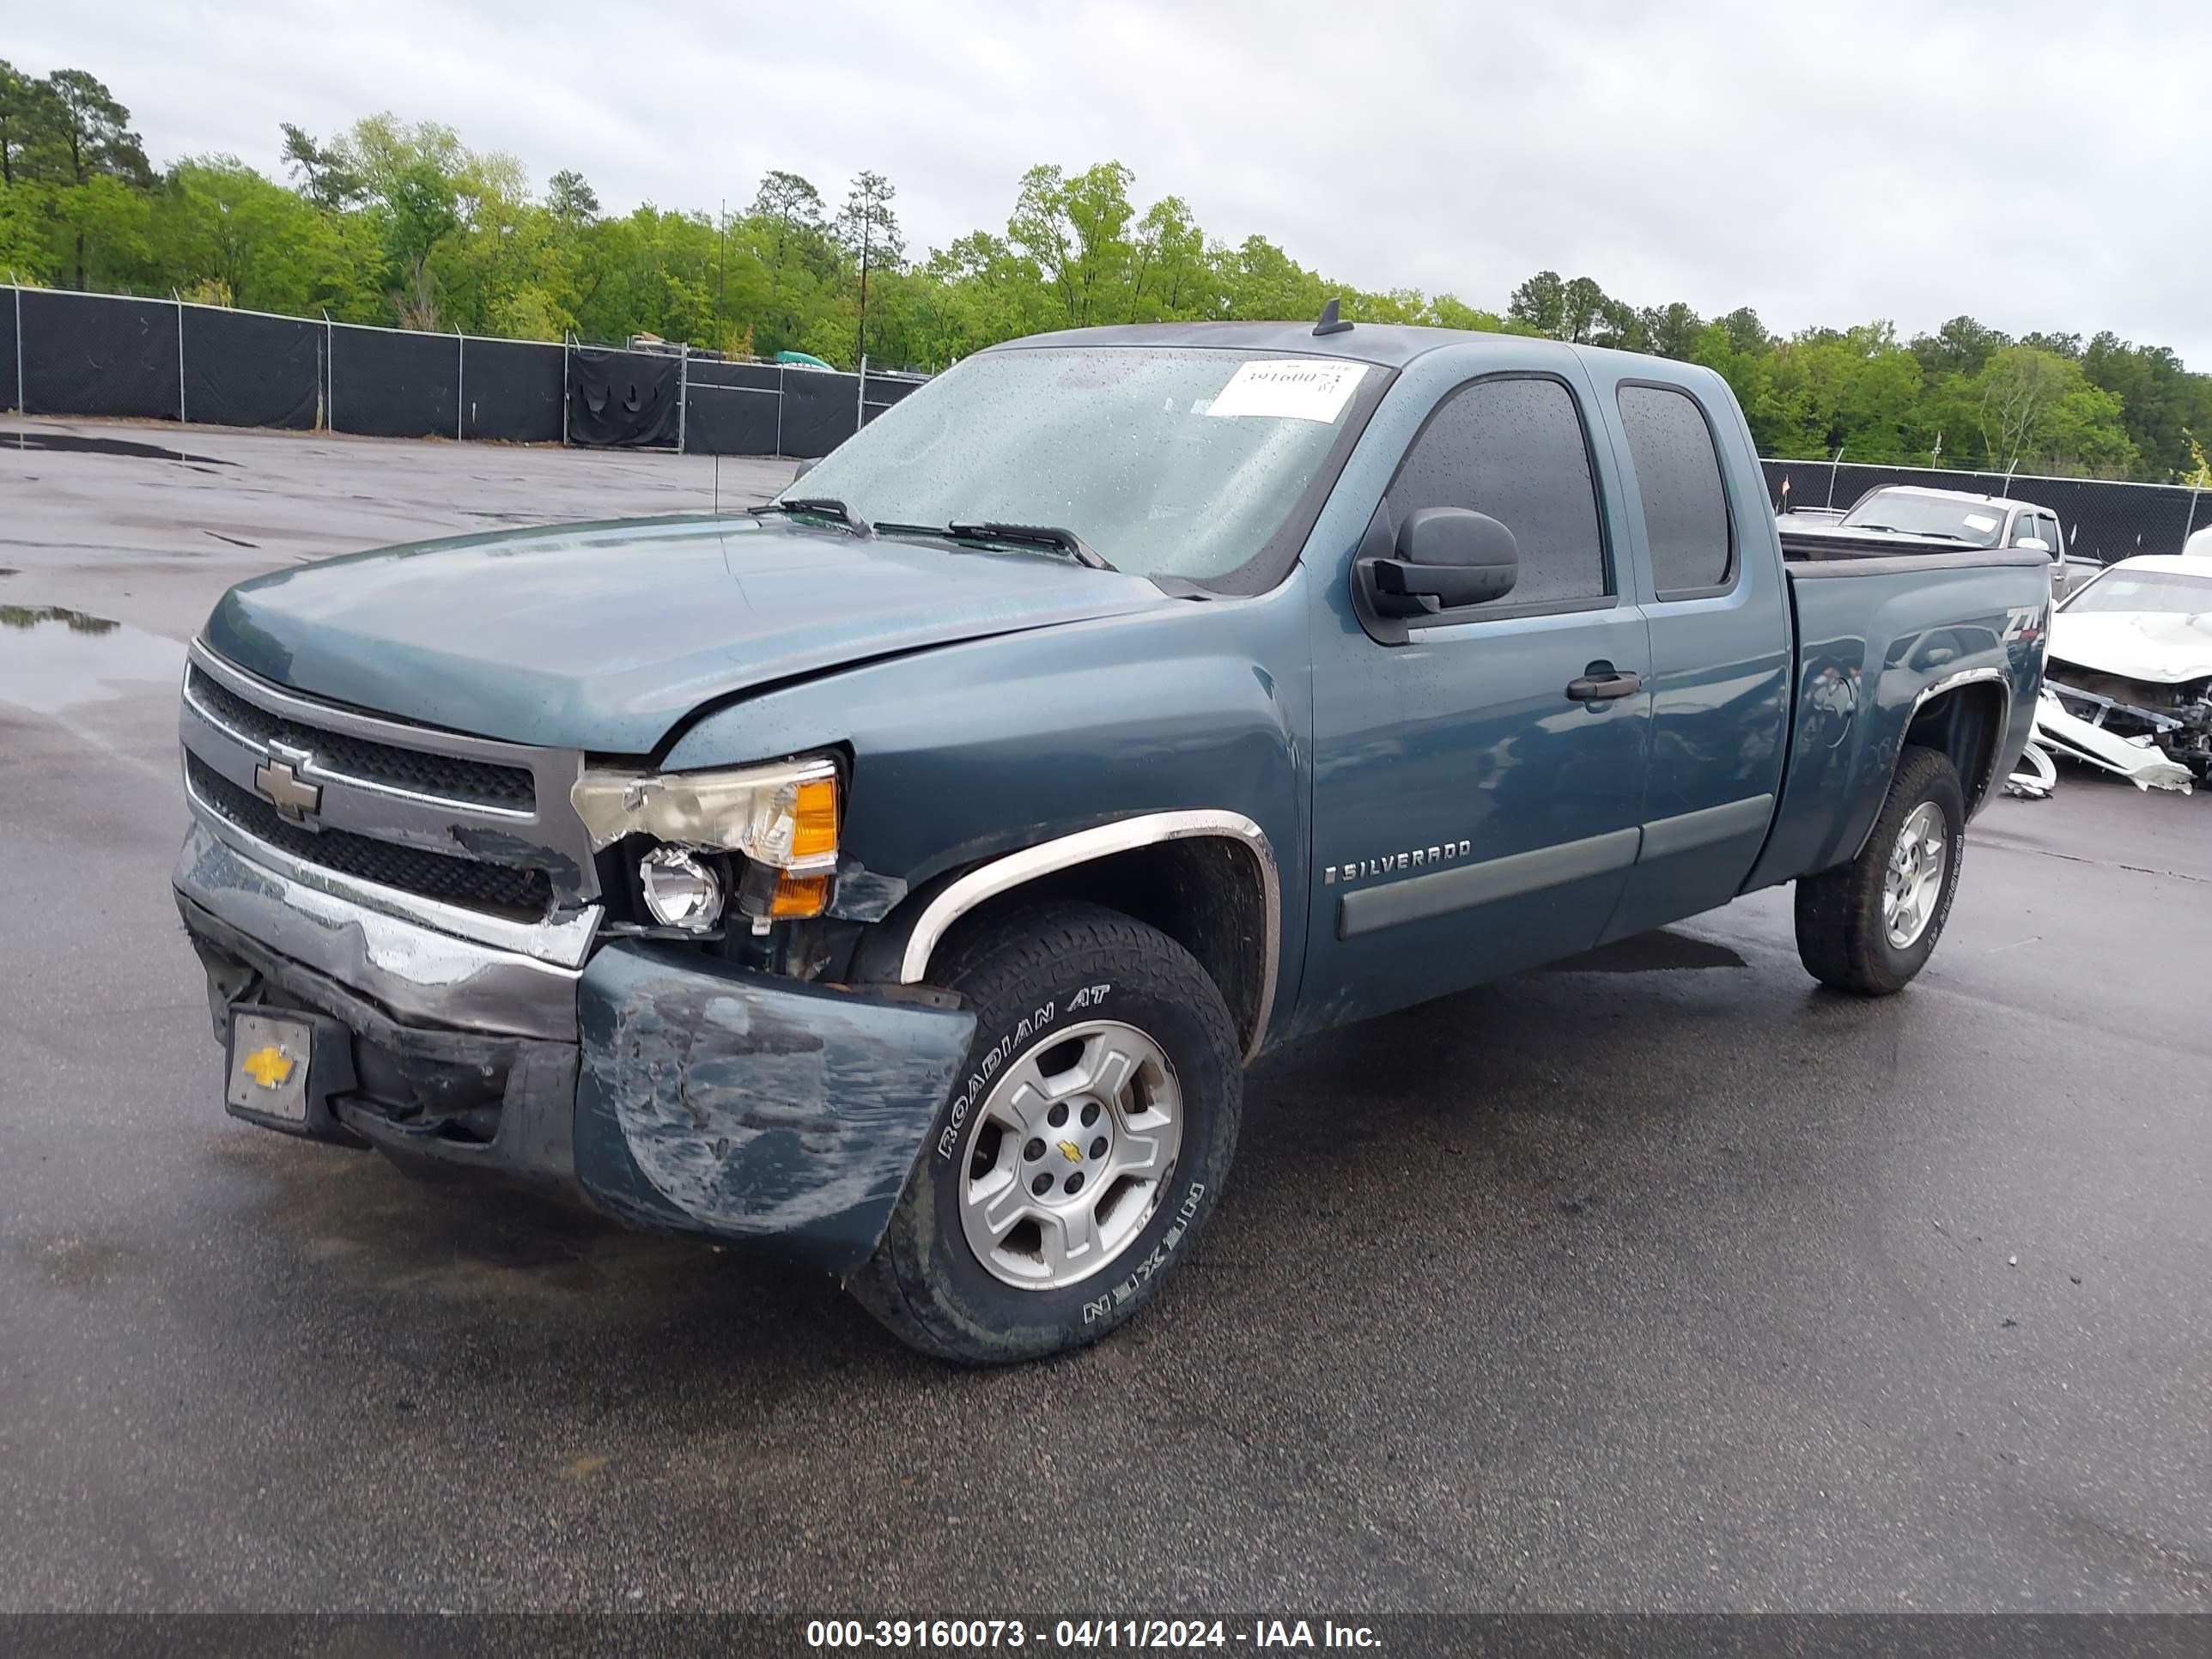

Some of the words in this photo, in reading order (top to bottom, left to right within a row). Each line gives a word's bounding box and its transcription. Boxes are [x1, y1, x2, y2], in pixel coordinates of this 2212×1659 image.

[2002, 605, 2040, 641] Z71
[1341, 840, 1471, 883] SILVERADO
[937, 1000, 1055, 1161] ROADIAN
[1066, 983, 1111, 1012] AT
[1083, 1182, 1206, 1324] NEXEN
